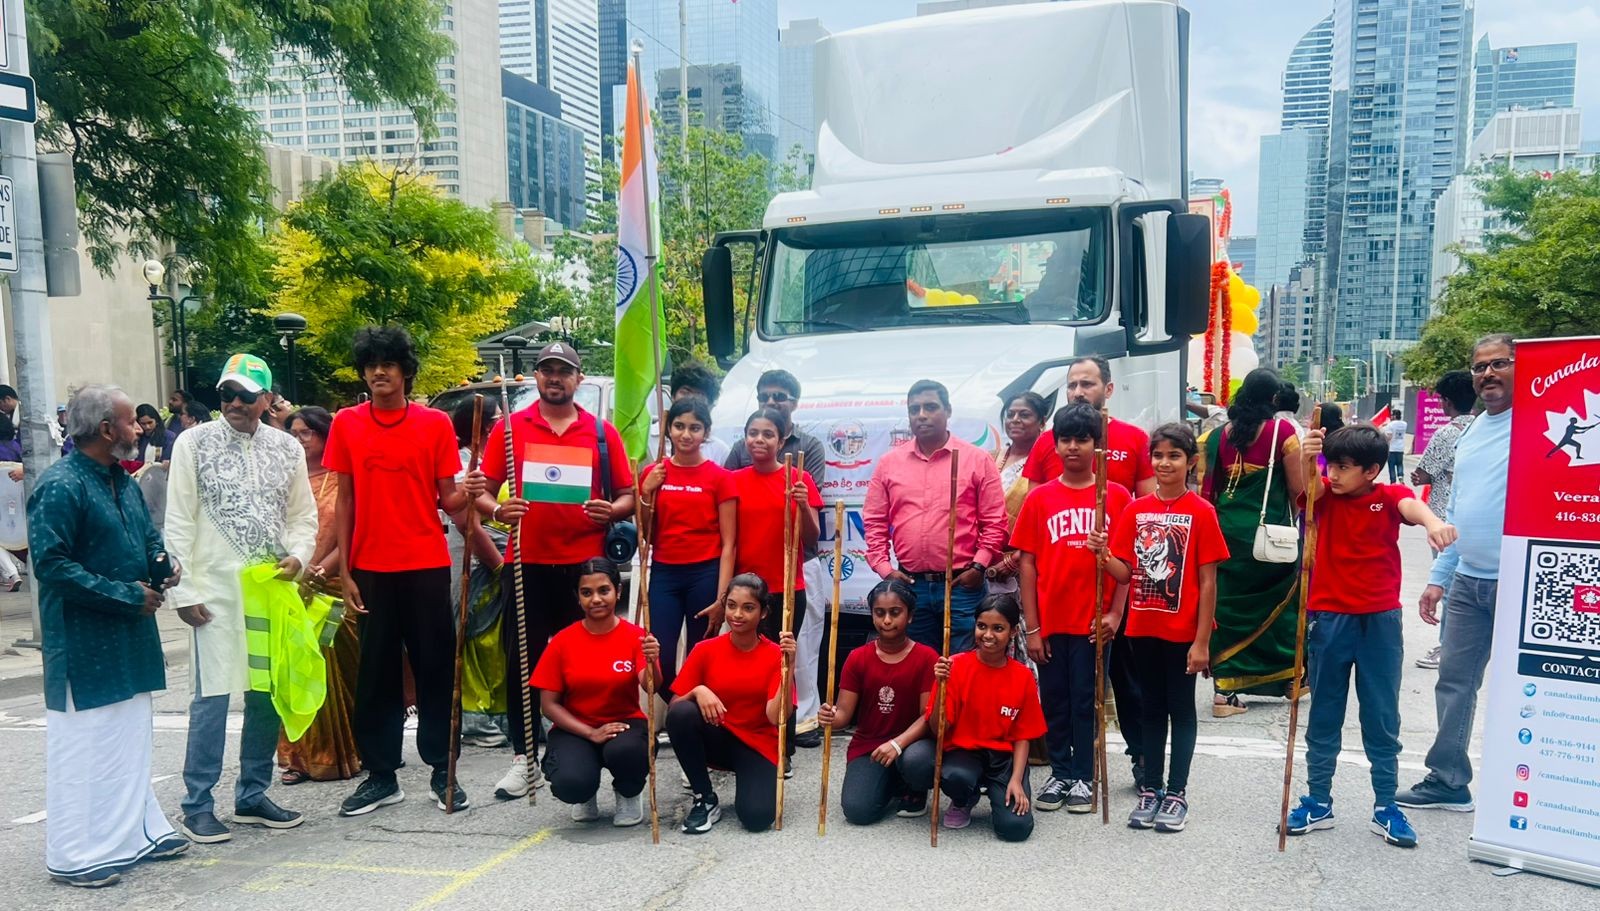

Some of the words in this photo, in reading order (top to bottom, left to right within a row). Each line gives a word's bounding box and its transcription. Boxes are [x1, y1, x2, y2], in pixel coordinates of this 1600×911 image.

[1531, 353, 1600, 397] Canada
[1554, 491, 1600, 503] Veera
[1047, 508, 1111, 545] VENI
[1165, 514, 1190, 525] TIGER
[613, 660, 633, 673] CS
[1542, 662, 1600, 679] CONTACT
